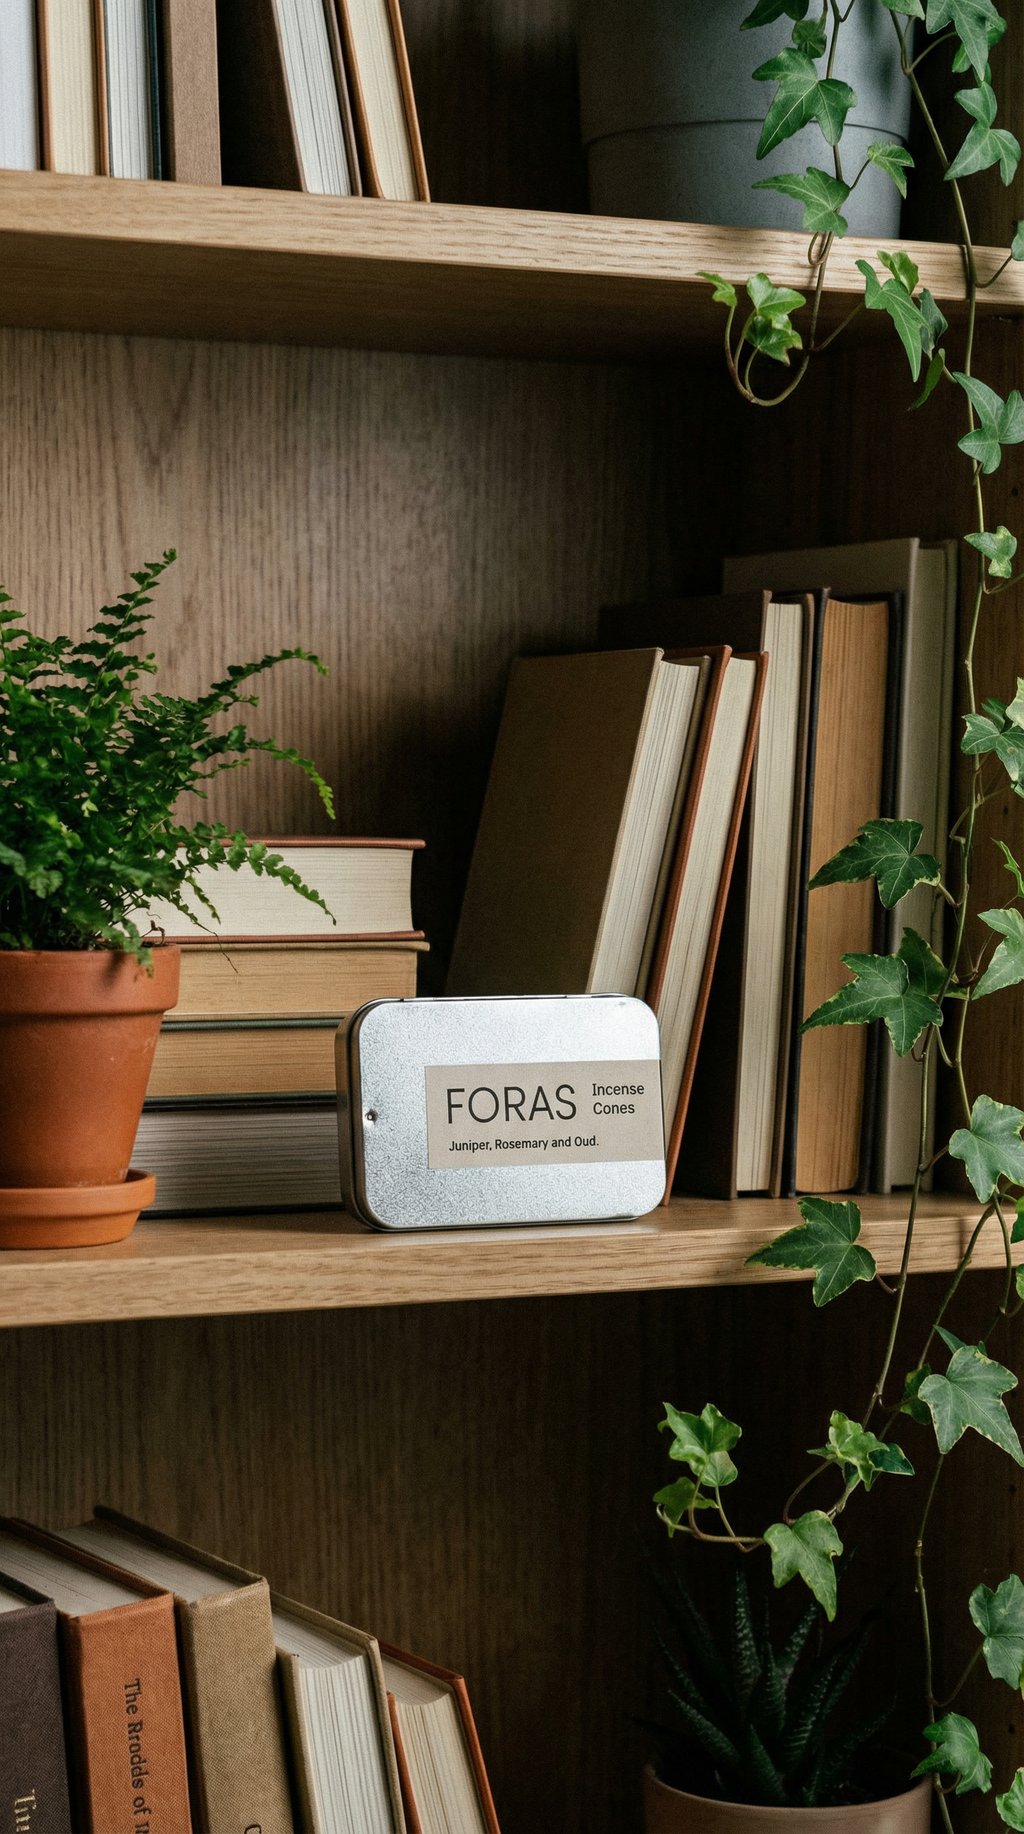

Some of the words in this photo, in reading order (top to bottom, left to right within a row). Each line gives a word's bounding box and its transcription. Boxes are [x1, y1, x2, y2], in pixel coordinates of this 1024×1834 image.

[592, 1083, 645, 1096] Incense
[446, 1084, 577, 1124] FORAS
[593, 1101, 635, 1115] Cones
[449, 1140, 492, 1153] Juniper,
[495, 1138, 548, 1151] Rosemary
[551, 1136, 571, 1147] and
[574, 1135, 600, 1147] Oud.
[124, 1678, 142, 1715] The
[133, 1796, 152, 1815] of
